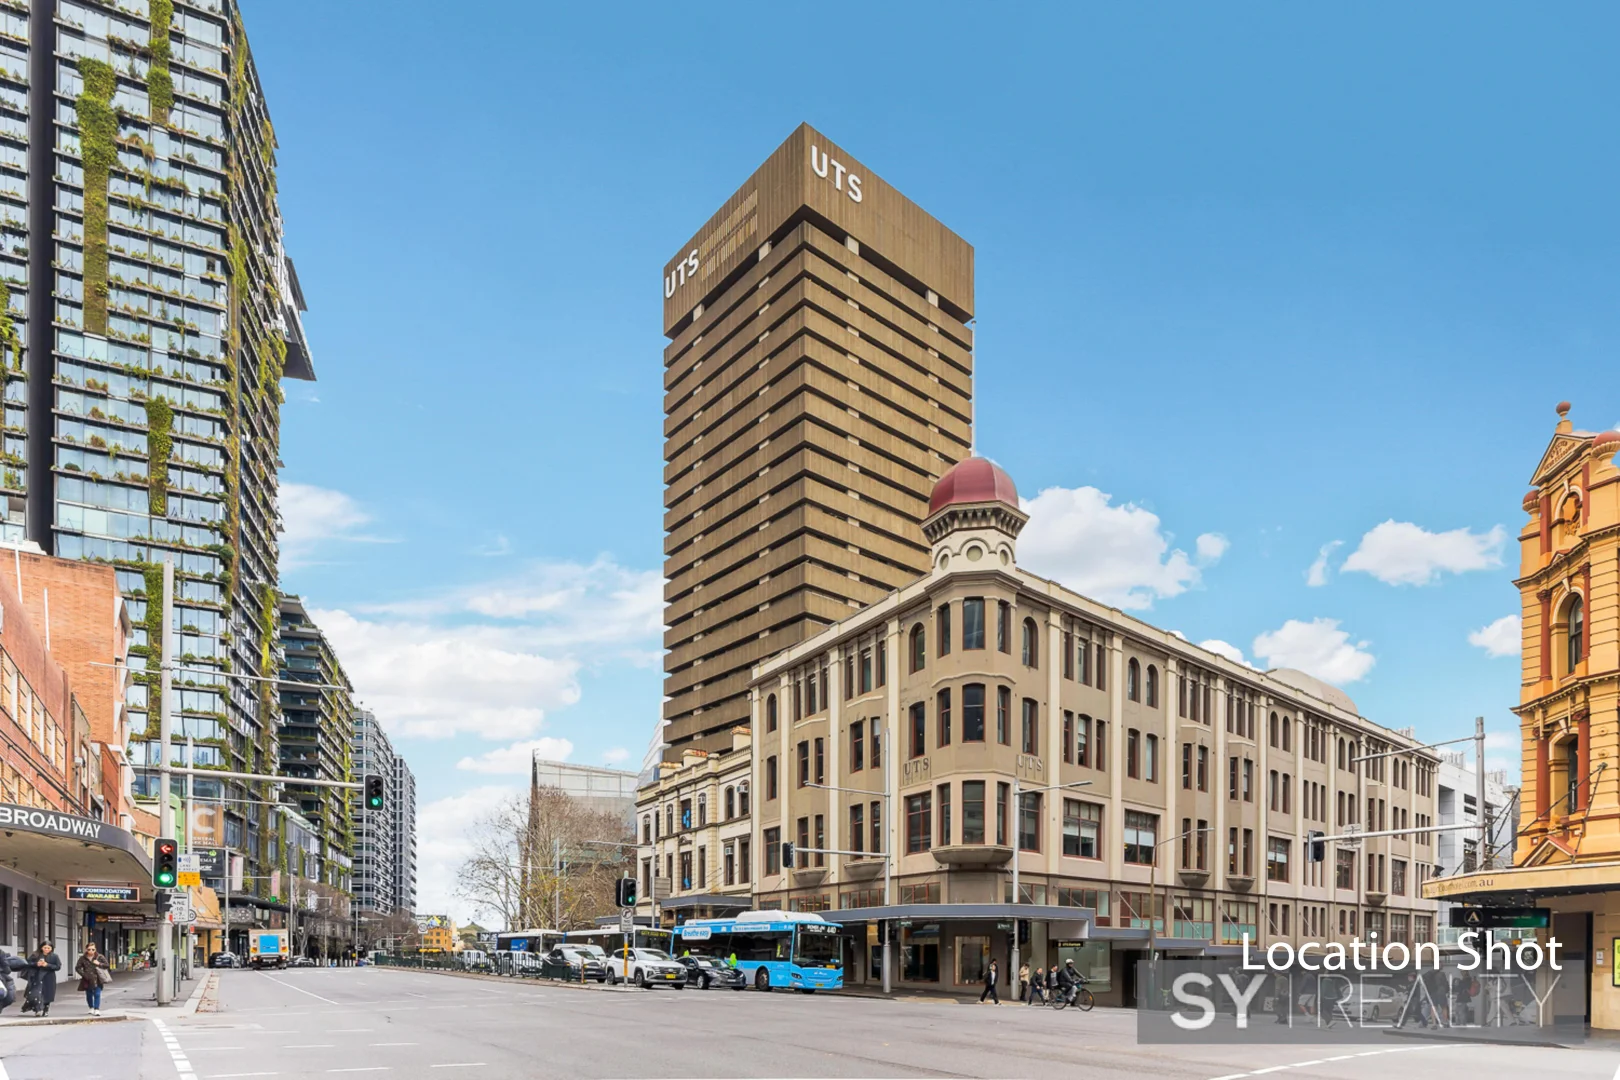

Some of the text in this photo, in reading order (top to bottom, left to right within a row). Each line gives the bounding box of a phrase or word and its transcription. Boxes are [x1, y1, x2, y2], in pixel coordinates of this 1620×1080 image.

[811, 145, 863, 204] UTS
[665, 248, 699, 299] UTS
[904, 757, 929, 775] UTS
[1016, 755, 1043, 772] UTS
[0, 806, 101, 839] BROADWAY
